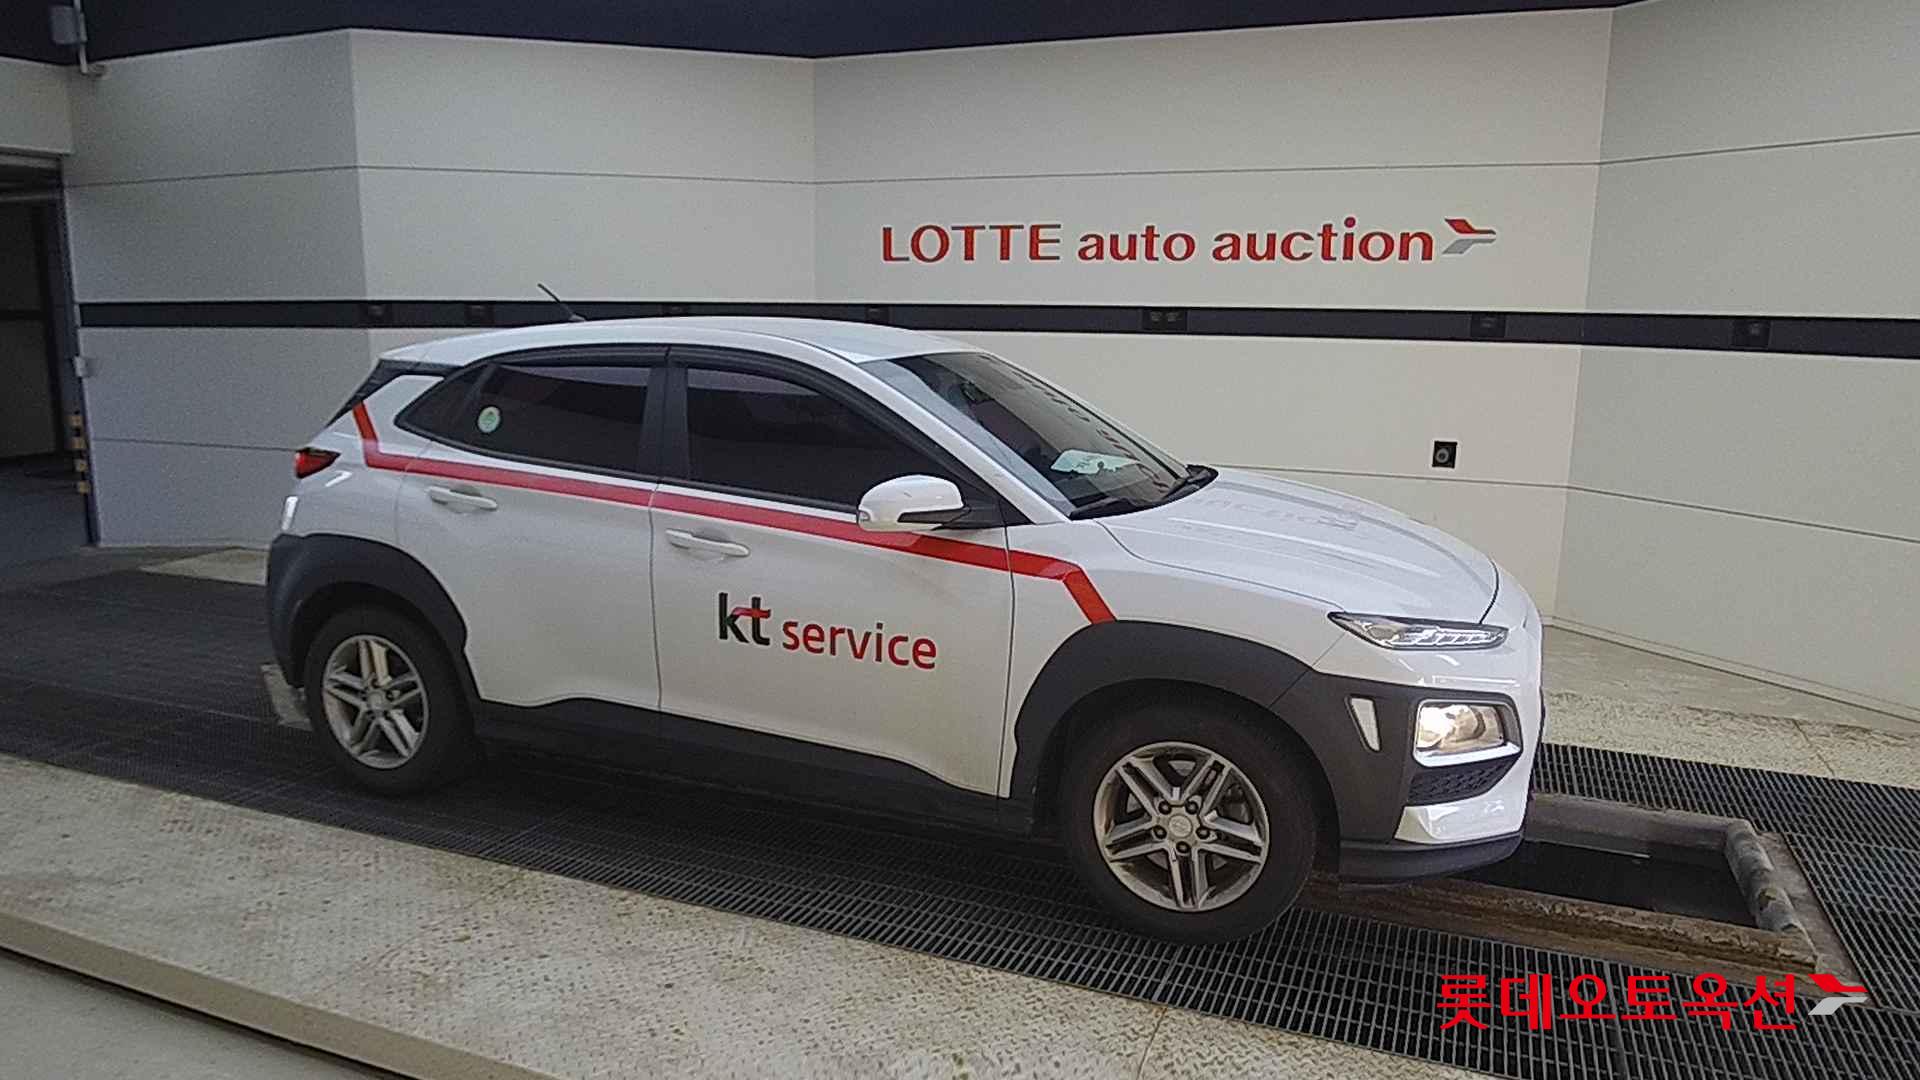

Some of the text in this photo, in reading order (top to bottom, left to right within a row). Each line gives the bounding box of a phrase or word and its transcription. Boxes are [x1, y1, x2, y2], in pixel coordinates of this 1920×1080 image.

[882, 216, 1435, 263] LOTTE auto auction
[718, 592, 938, 670] kt service
